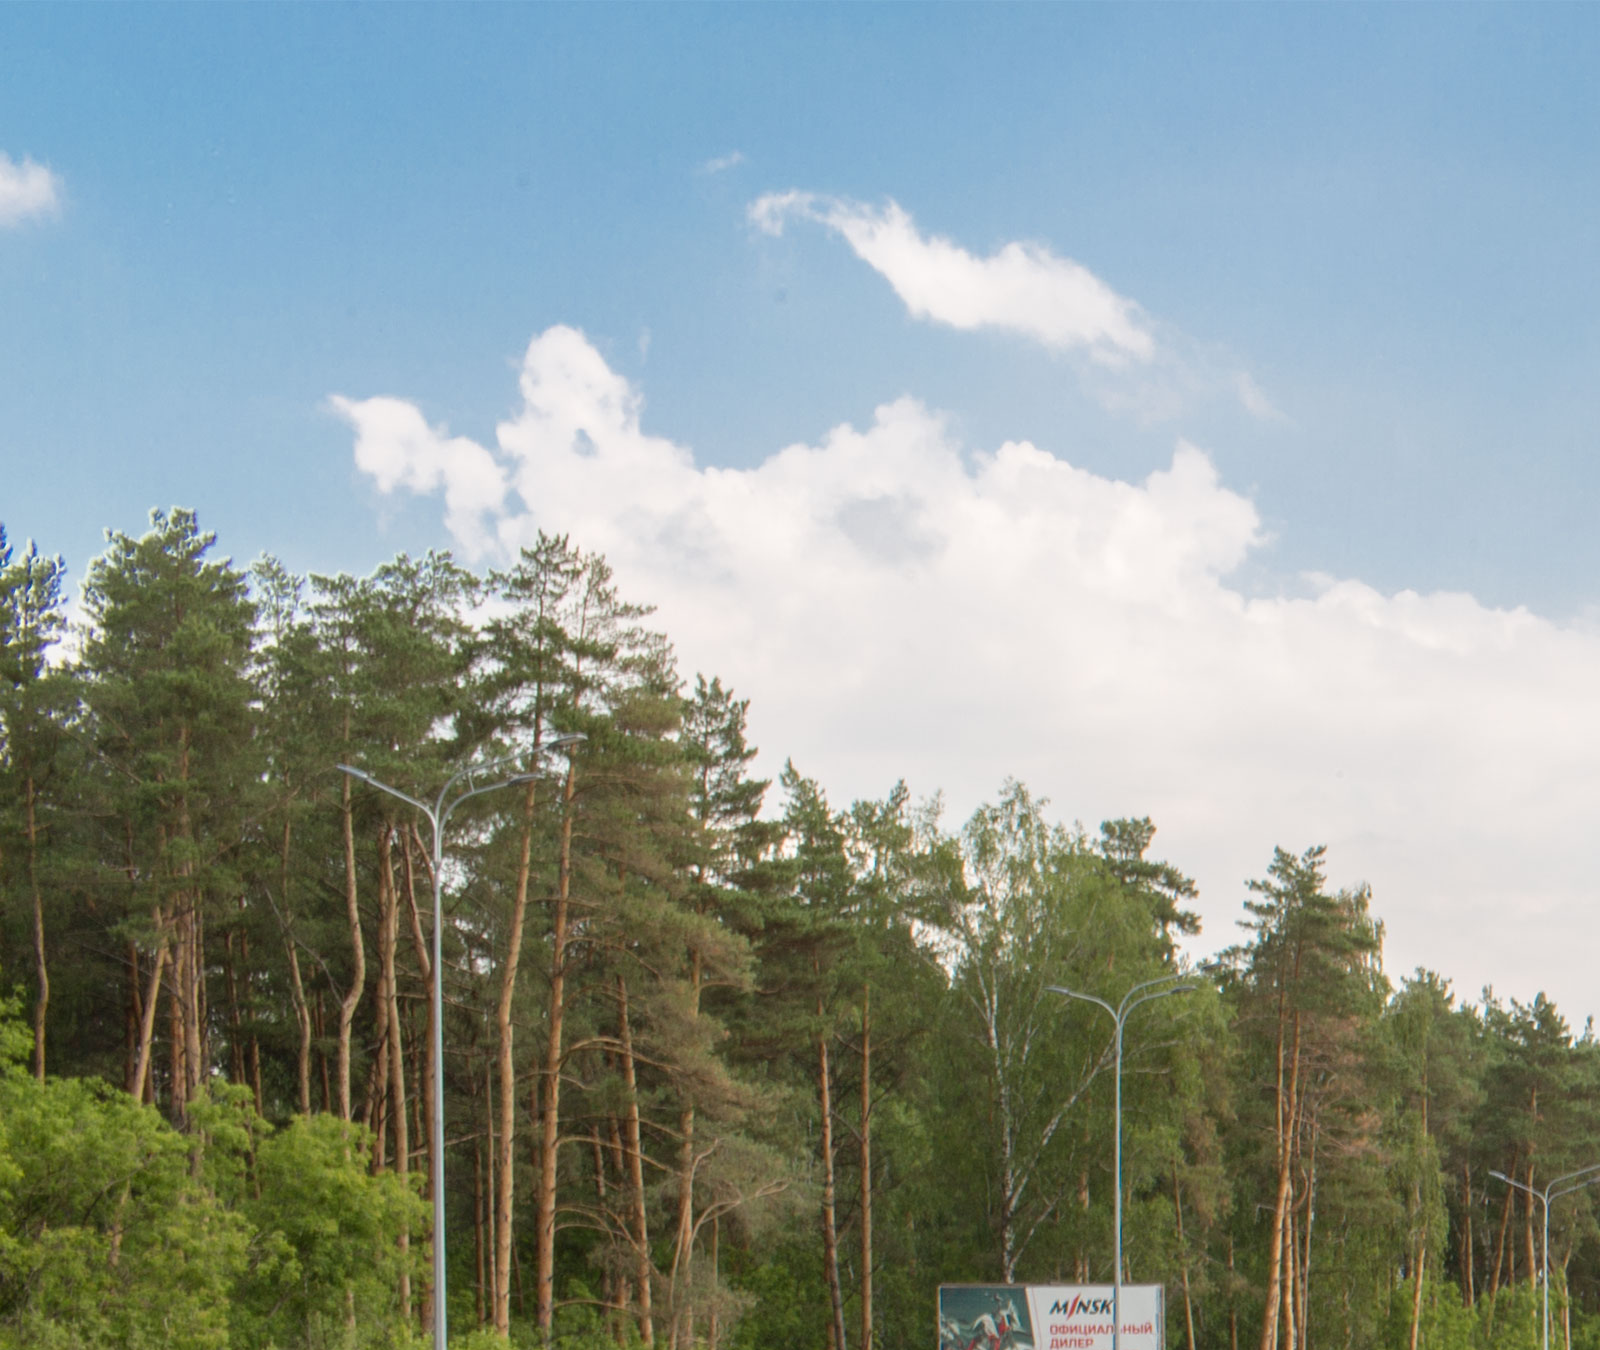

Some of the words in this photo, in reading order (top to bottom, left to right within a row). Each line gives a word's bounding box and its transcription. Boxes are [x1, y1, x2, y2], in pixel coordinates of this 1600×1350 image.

[1049, 1293, 1115, 1320] MINSK
[1049, 1322, 1153, 1336] ОФИЦИАЛНЫЙ
[1049, 1338, 1094, 1350] ДИЛЕР
